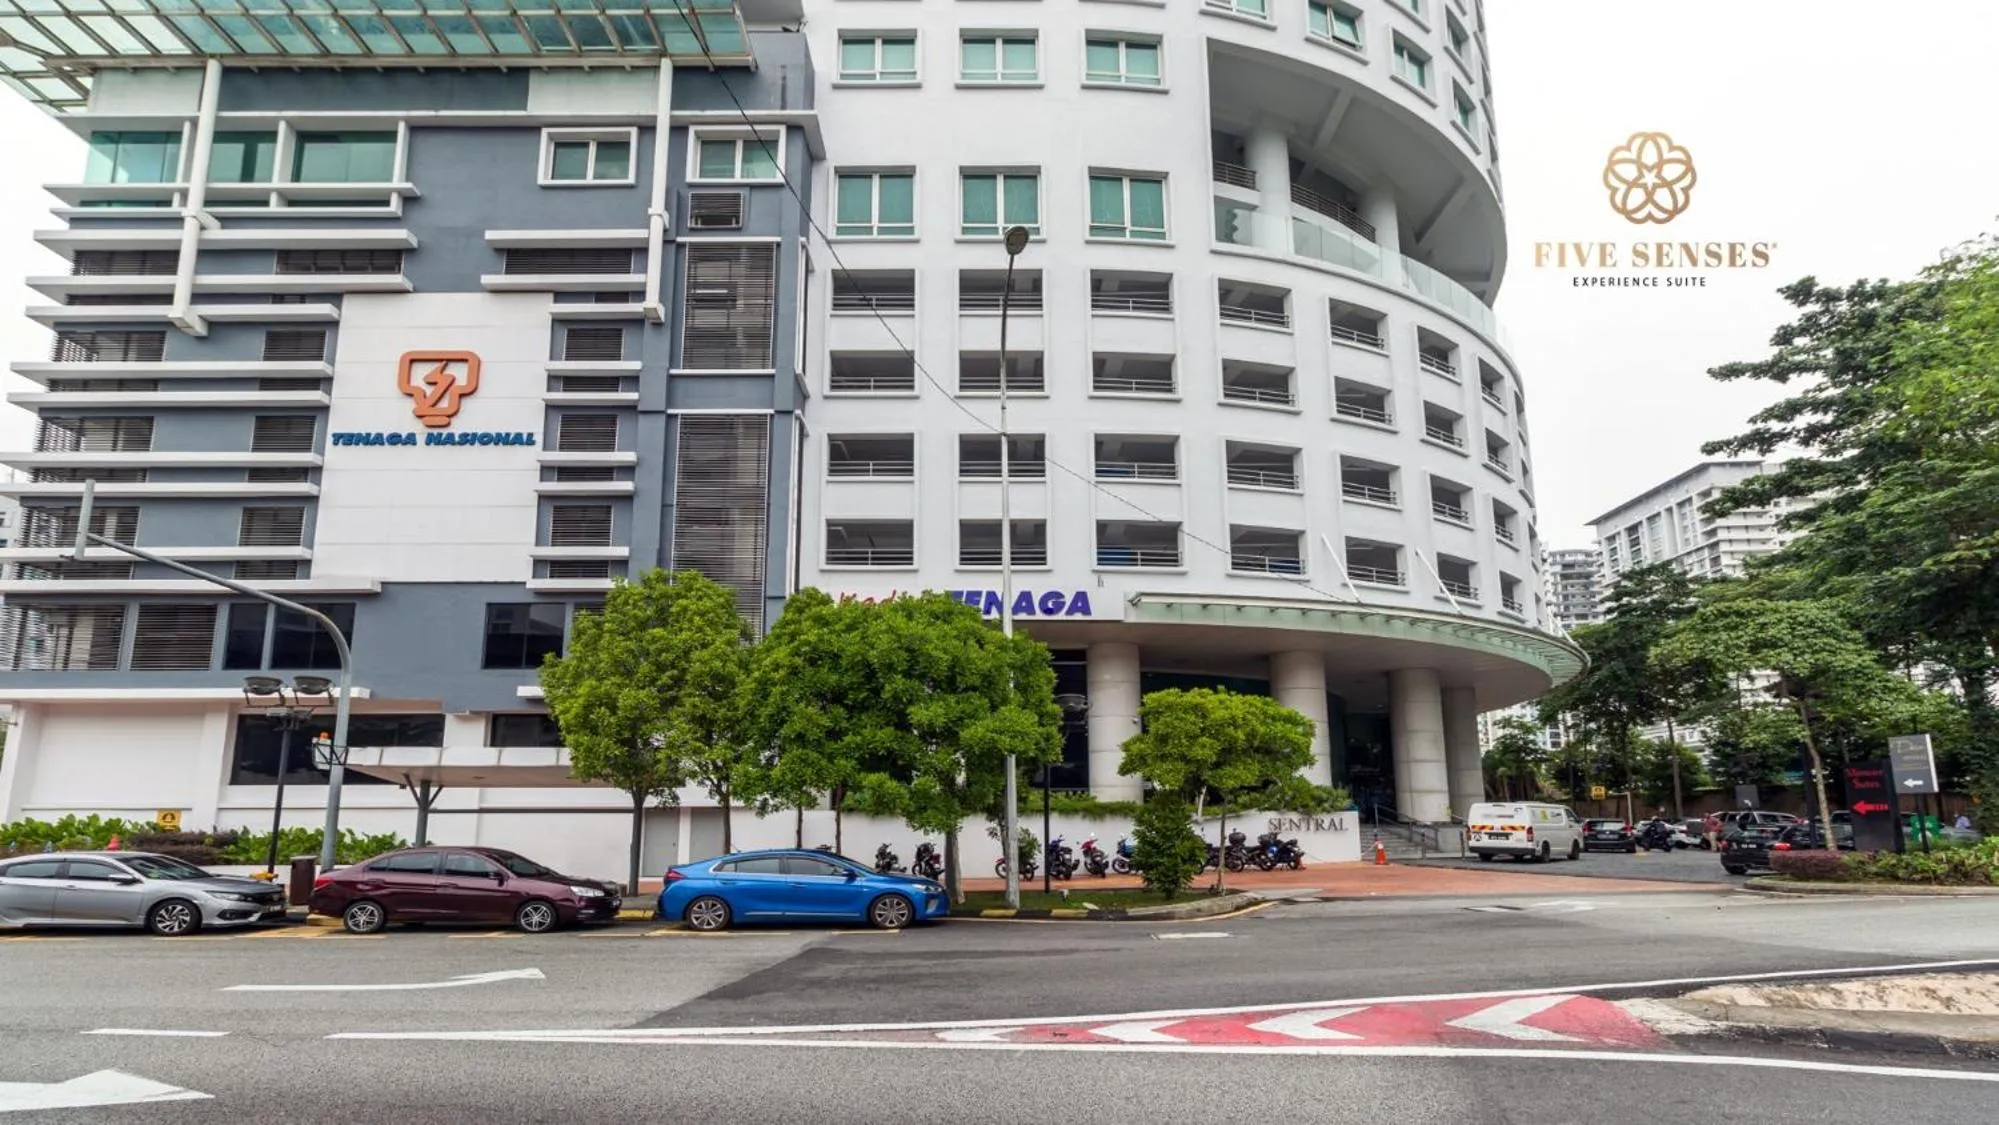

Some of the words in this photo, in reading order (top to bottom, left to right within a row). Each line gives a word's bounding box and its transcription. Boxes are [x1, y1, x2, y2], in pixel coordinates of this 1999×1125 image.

[331, 431, 418, 446] TENAGA
[424, 431, 536, 446] NASIONAL
[1268, 816, 1349, 833] SENTRAL
